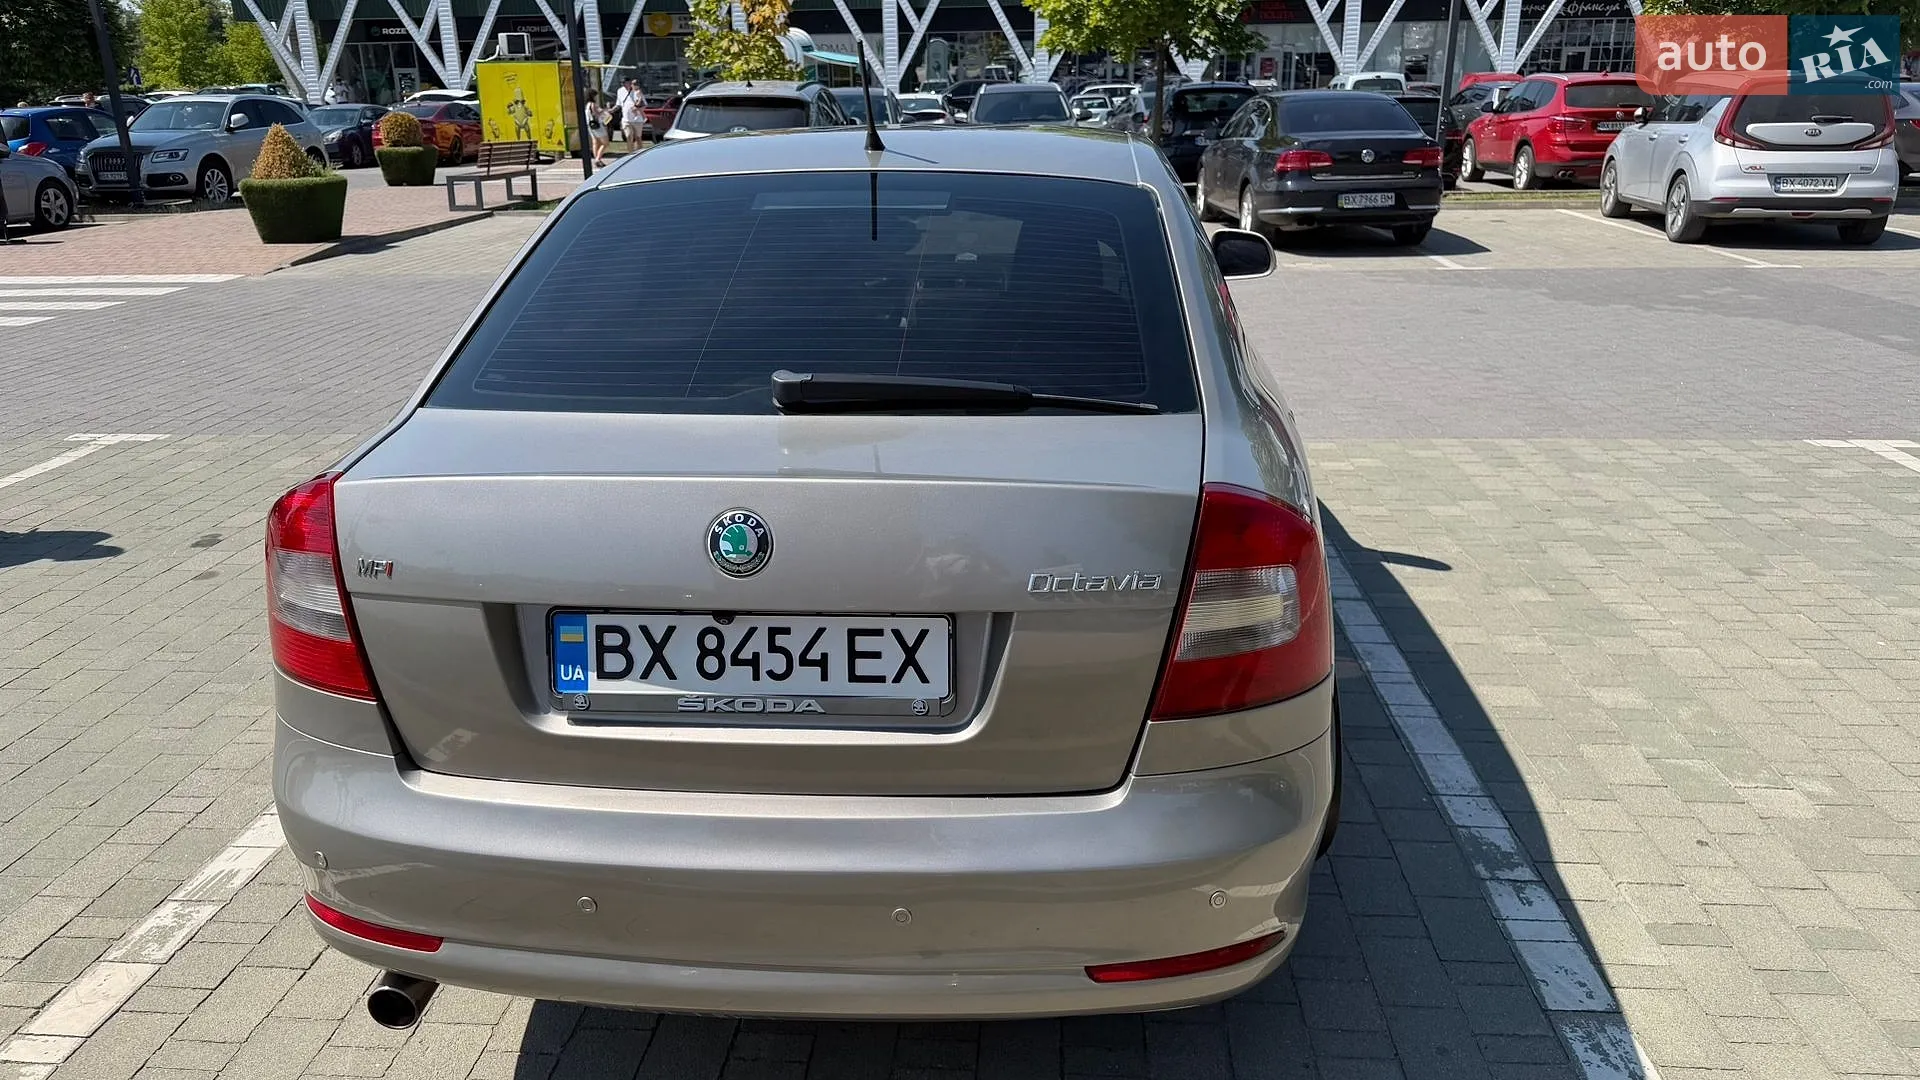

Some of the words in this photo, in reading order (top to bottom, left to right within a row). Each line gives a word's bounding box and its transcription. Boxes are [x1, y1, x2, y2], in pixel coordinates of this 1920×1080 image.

[1782, 178, 1796, 188] BX
[1797, 178, 1819, 188] 4072
[357, 557, 393, 580] MPI
[1027, 570, 1162, 593] Octavia
[594, 624, 678, 681] BX
[695, 625, 829, 682] 8454
[846, 628, 930, 684] EX
[560, 664, 585, 681] UA
